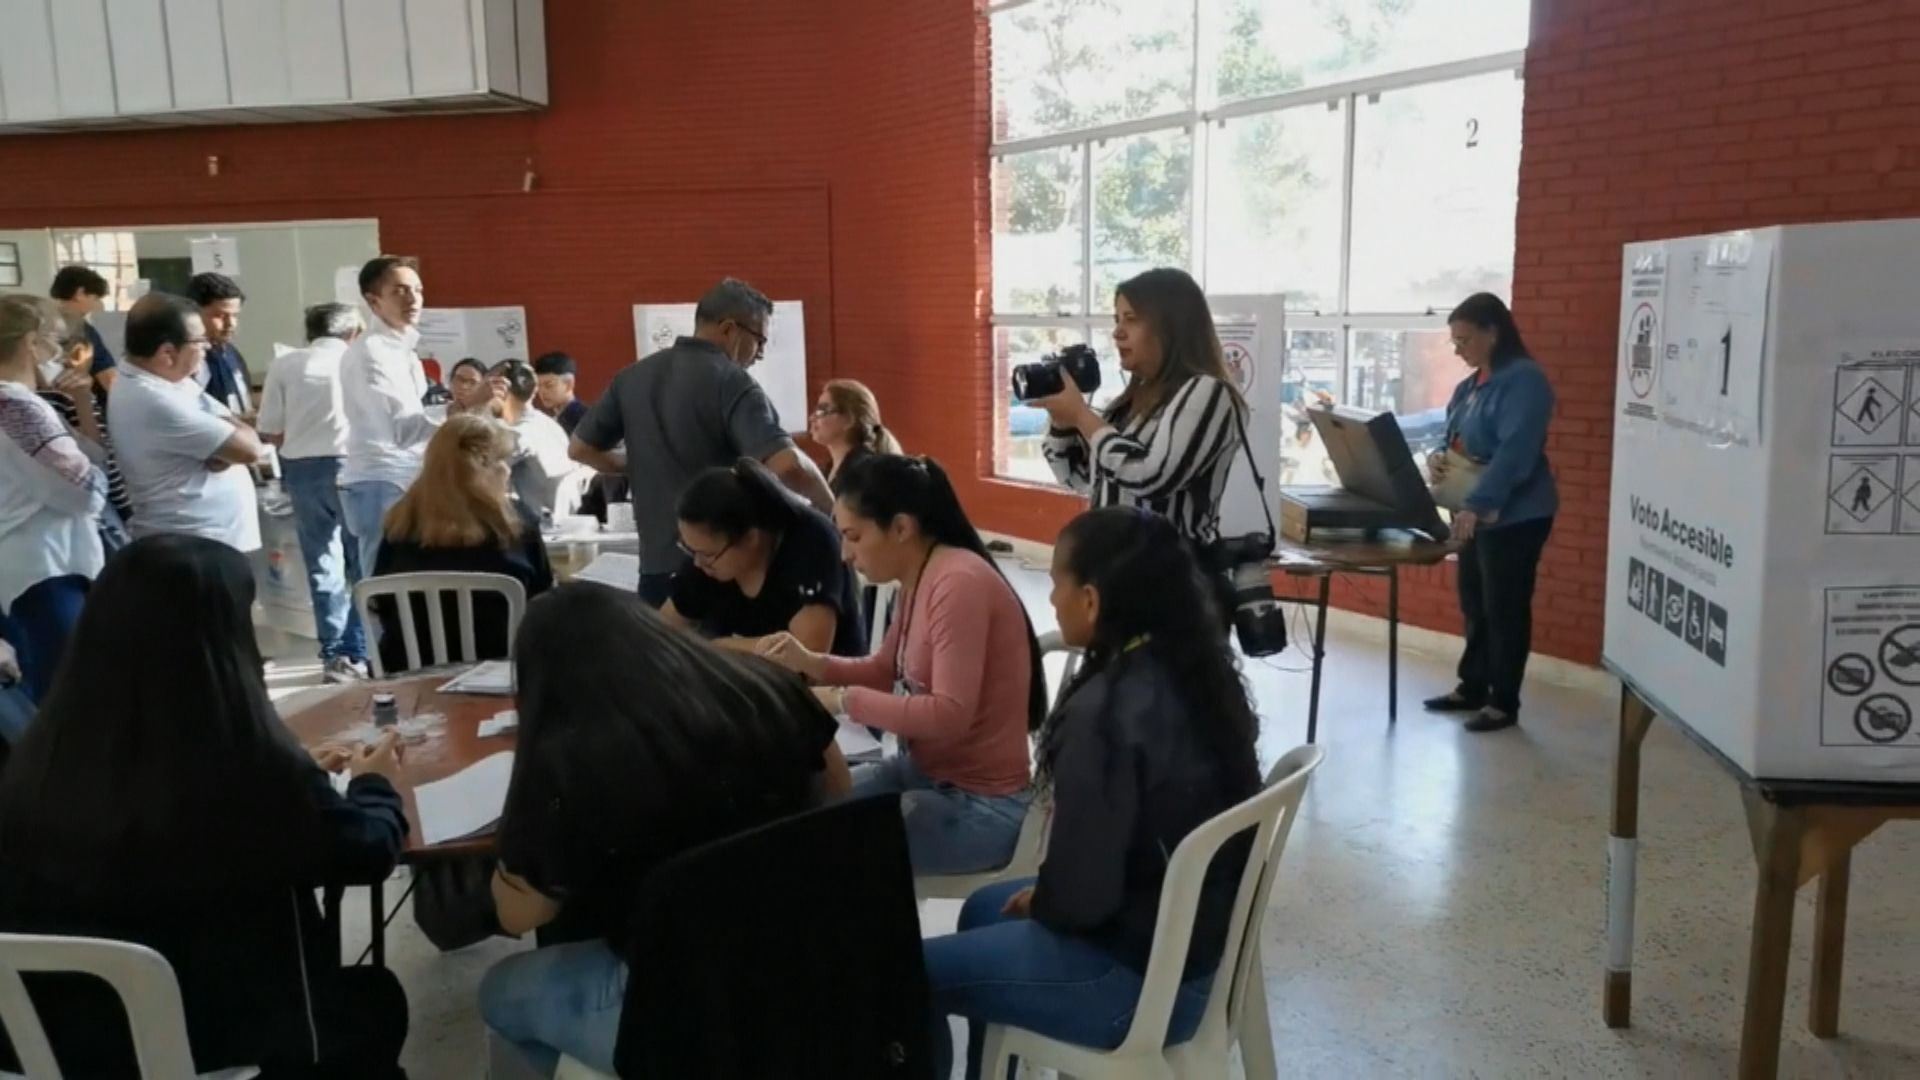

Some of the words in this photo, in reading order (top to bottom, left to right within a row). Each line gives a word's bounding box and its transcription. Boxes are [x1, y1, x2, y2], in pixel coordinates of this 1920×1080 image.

[1466, 118, 1479, 149] 2
[214, 253, 224, 269] 5
[1719, 323, 1732, 397] 1
[1629, 494, 1660, 531] Voto
[1661, 507, 1734, 568] Accesible
